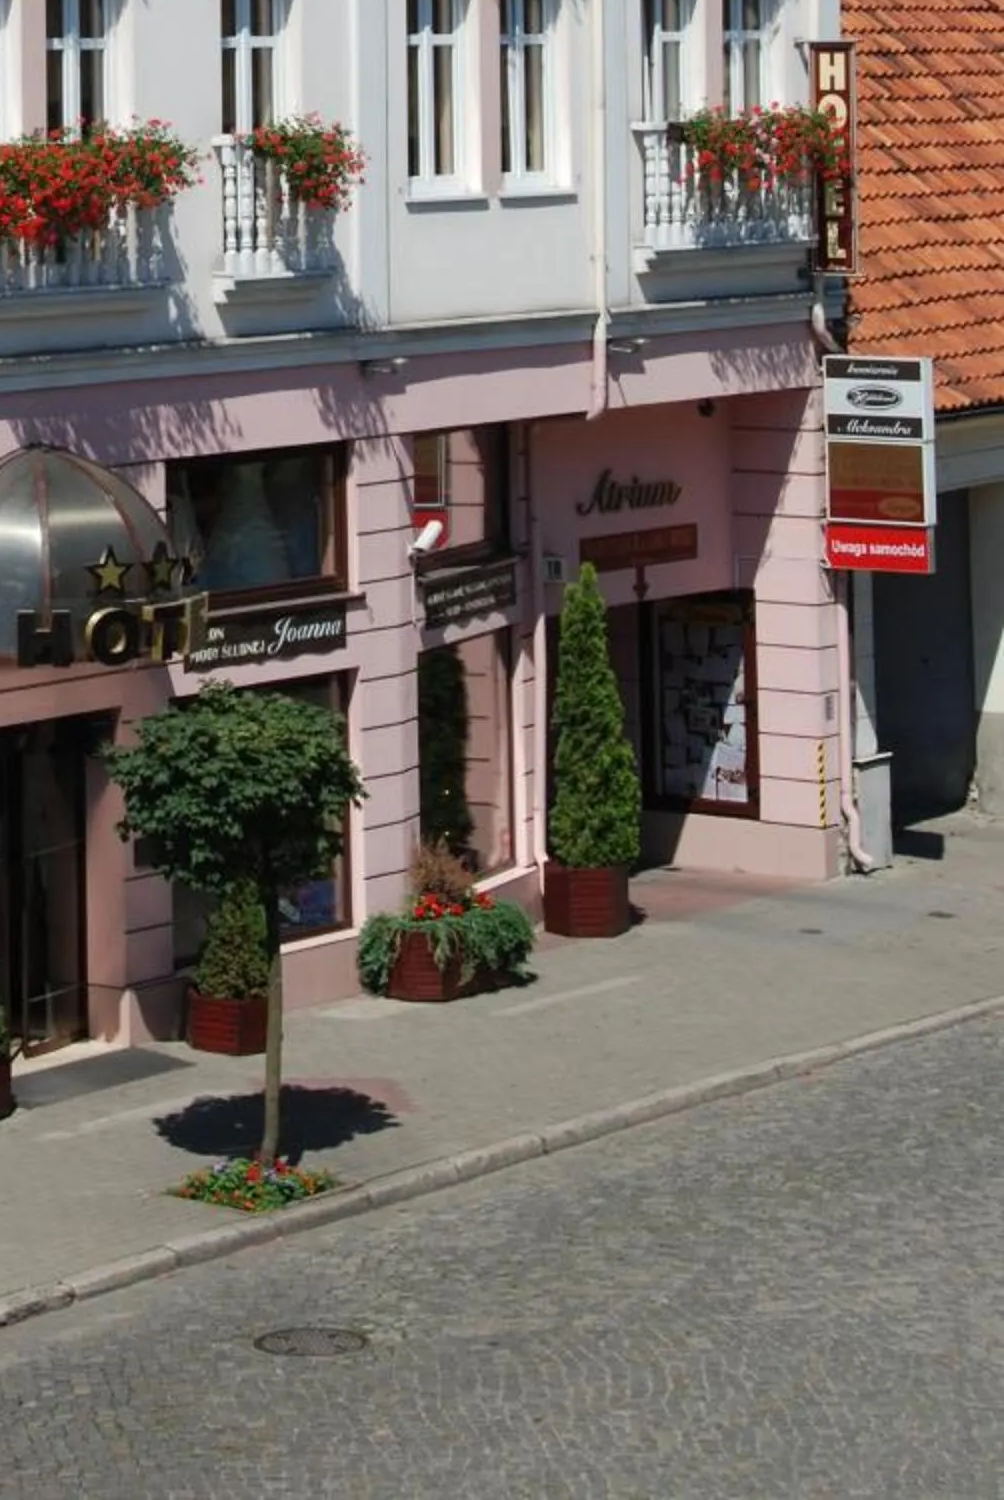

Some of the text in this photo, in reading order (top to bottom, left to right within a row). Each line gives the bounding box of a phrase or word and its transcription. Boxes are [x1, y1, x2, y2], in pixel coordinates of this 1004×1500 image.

[818, 52, 847, 259] HOEL
[575, 467, 682, 516] Atrium
[831, 540, 925, 558] Uwaga samochód
[267, 615, 343, 655] Joanna
